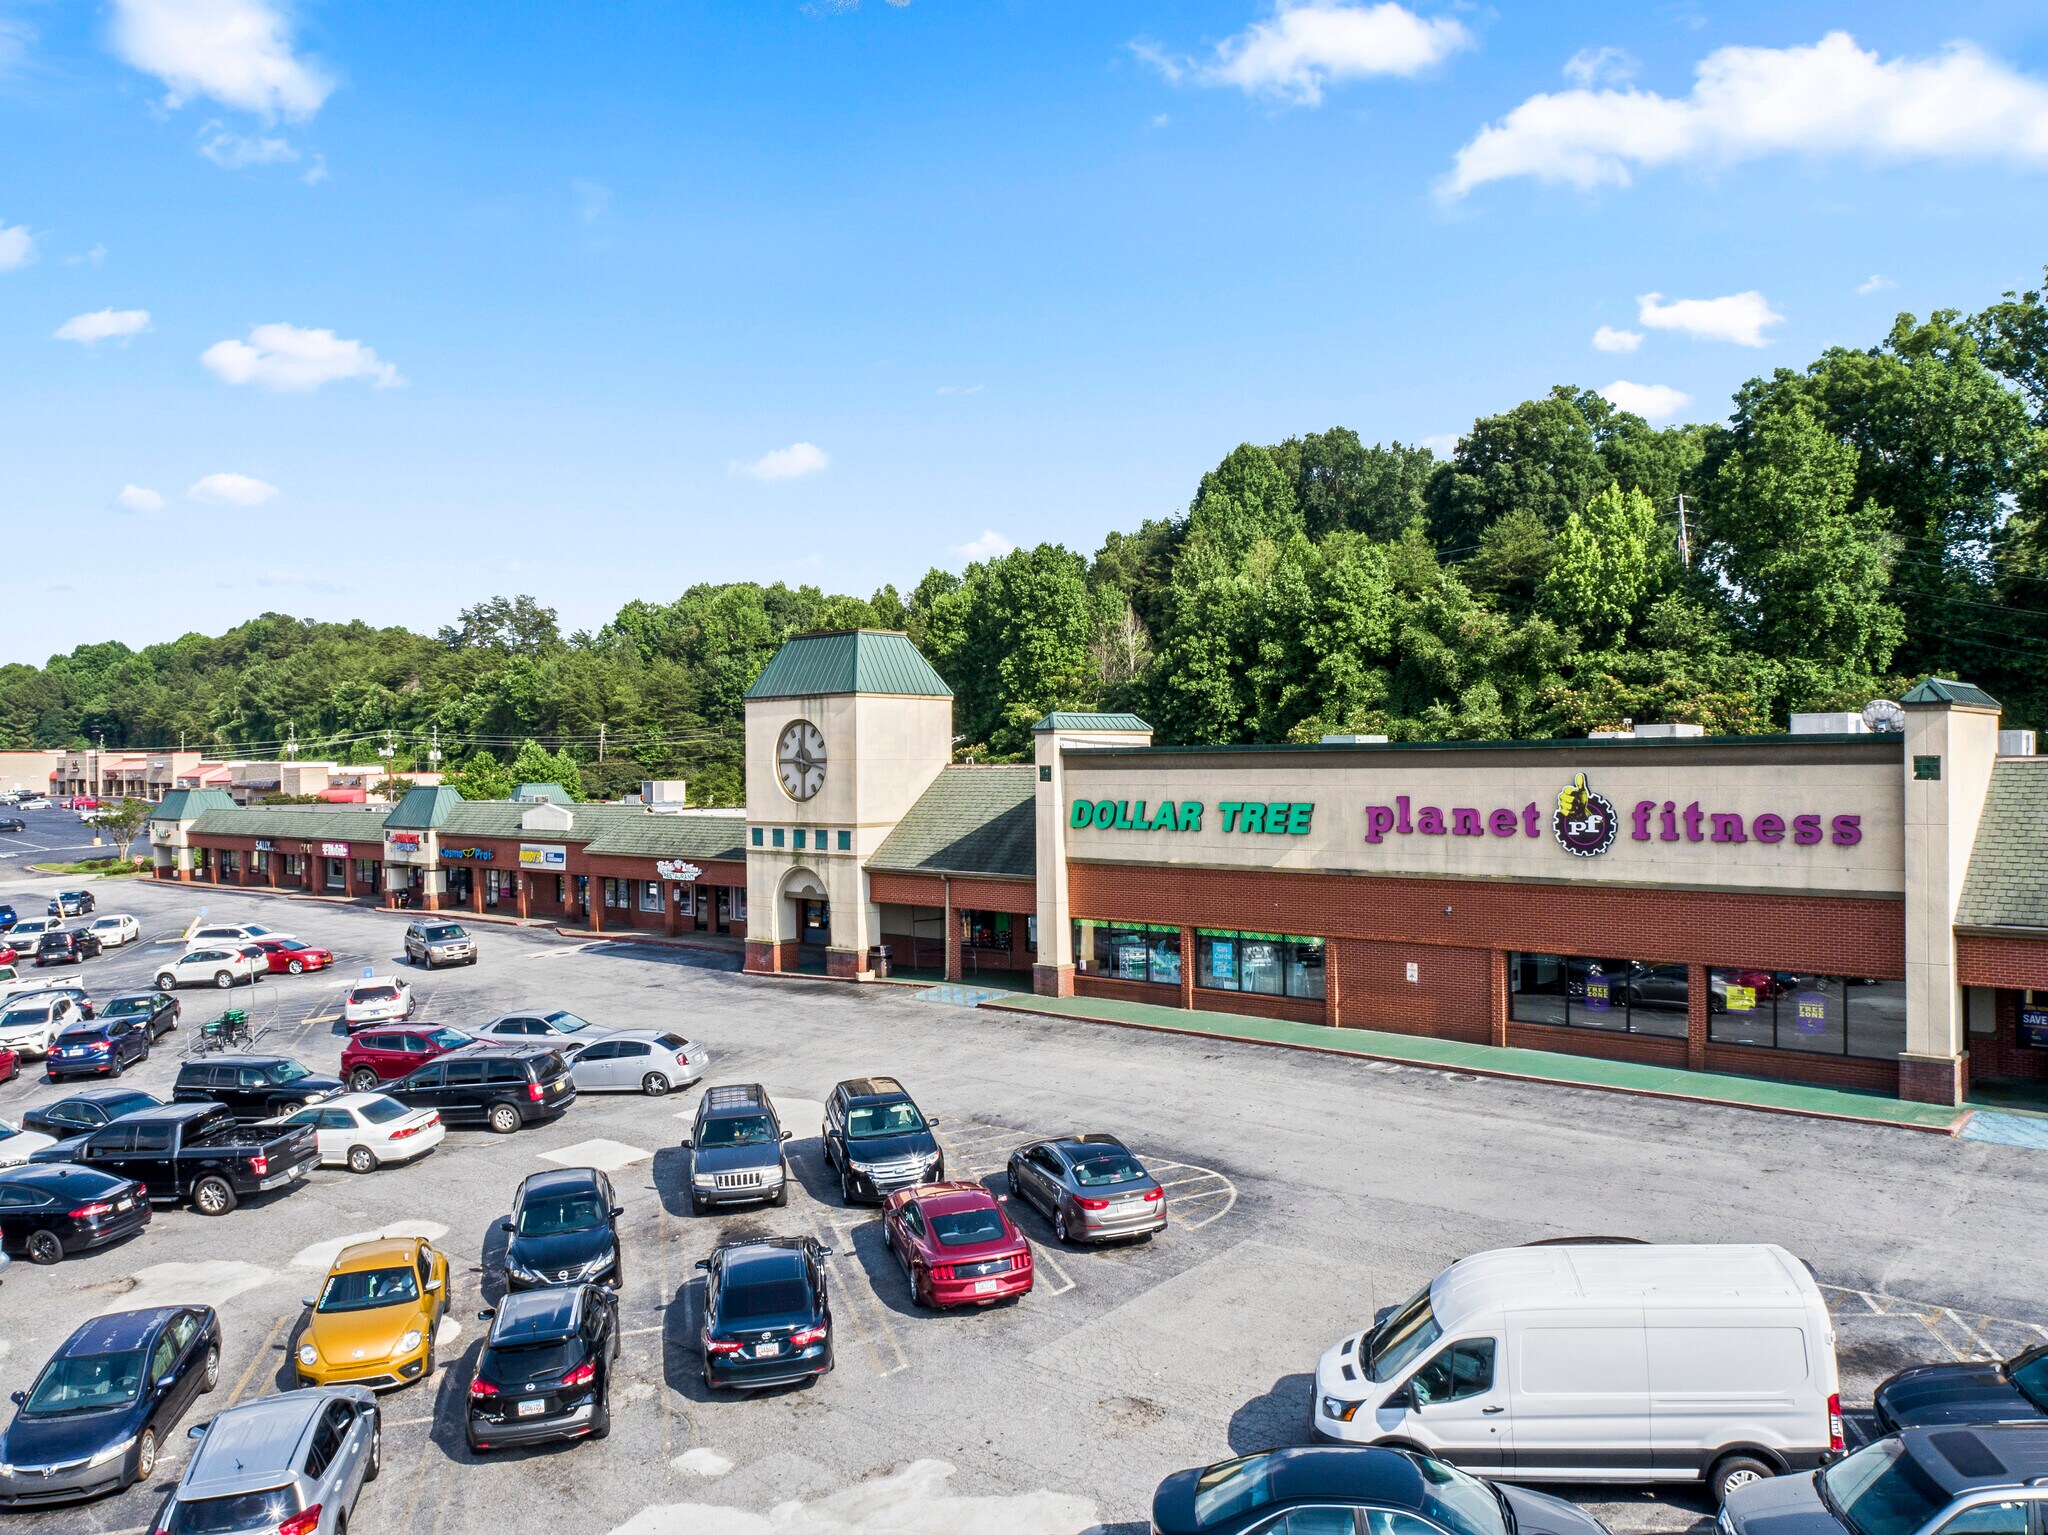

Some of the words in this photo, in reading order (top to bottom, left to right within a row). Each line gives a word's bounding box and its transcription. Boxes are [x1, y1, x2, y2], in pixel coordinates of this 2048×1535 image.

[1070, 799, 1203, 831] DOLLAR
[1218, 802, 1315, 834] TREE
[1365, 796, 1540, 843] planet
[1632, 801, 1862, 845] fitness
[1568, 814, 1603, 836] pf
[255, 840, 271, 850] SALLY
[440, 846, 463, 858] Cosmo
[1799, 1006, 1824, 1014] FREE
[1799, 1011, 1824, 1019] ZONE
[2023, 1014, 2048, 1025] SAVE
